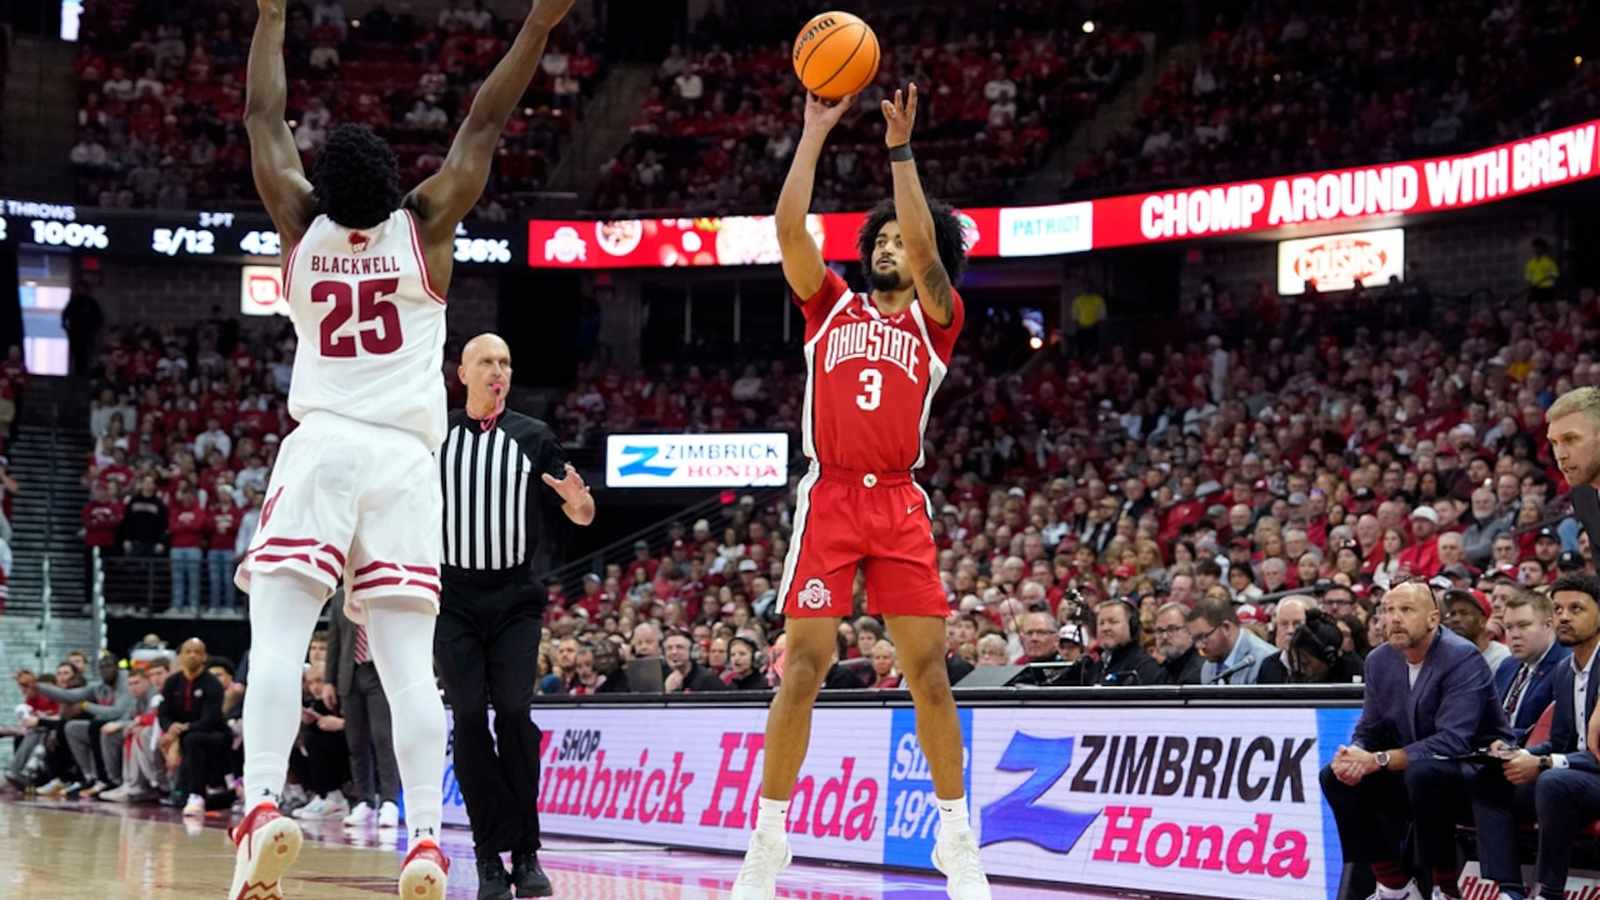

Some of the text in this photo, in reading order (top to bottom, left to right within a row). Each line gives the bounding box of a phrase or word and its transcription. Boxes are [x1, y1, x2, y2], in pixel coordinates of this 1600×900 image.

[1140, 125, 1596, 239] CHOMP AROUND WITH BREW
[8, 200, 76, 221] THROWS
[199, 212, 235, 227] 3-PT
[31, 220, 109, 248] 100%
[152, 226, 215, 256] 5/12
[240, 231, 281, 254] 42
[311, 255, 401, 275] BLACKWELL
[310, 277, 404, 358] 25
[855, 368, 884, 412] 3
[664, 444, 780, 460] ZIMBRICK
[687, 464, 780, 479] HONDA
[559, 729, 601, 762] SHOP
[1070, 735, 1317, 803] ZIMBRICK
[699, 732, 879, 841] Hnda
[887, 790, 942, 839] 197
[1092, 806, 1311, 880] Honda
